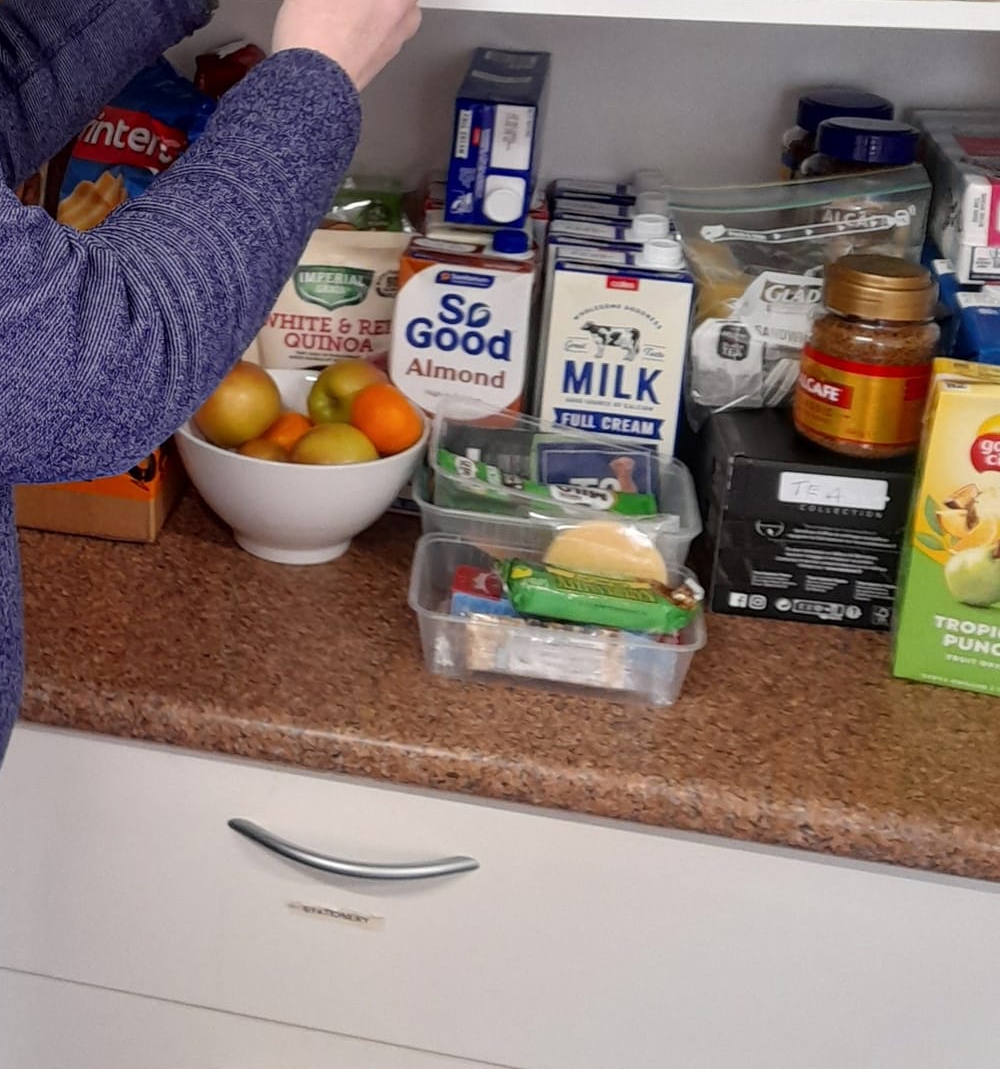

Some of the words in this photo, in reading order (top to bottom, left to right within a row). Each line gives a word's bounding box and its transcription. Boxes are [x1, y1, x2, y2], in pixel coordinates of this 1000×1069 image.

[299, 272, 364, 286] IMPERIAL
[764, 284, 822, 303] GLAD
[438, 293, 492, 328] So
[338, 318, 352, 334] &
[284, 332, 374, 353] QUINOA
[405, 317, 512, 361] Good
[405, 357, 506, 389] Almond
[562, 360, 663, 405] MILK
[560, 412, 597, 429] FULL
[601, 416, 655, 436] CREAM
[791, 480, 843, 504] TEA
[799, 504, 883, 519] COLLECTION
